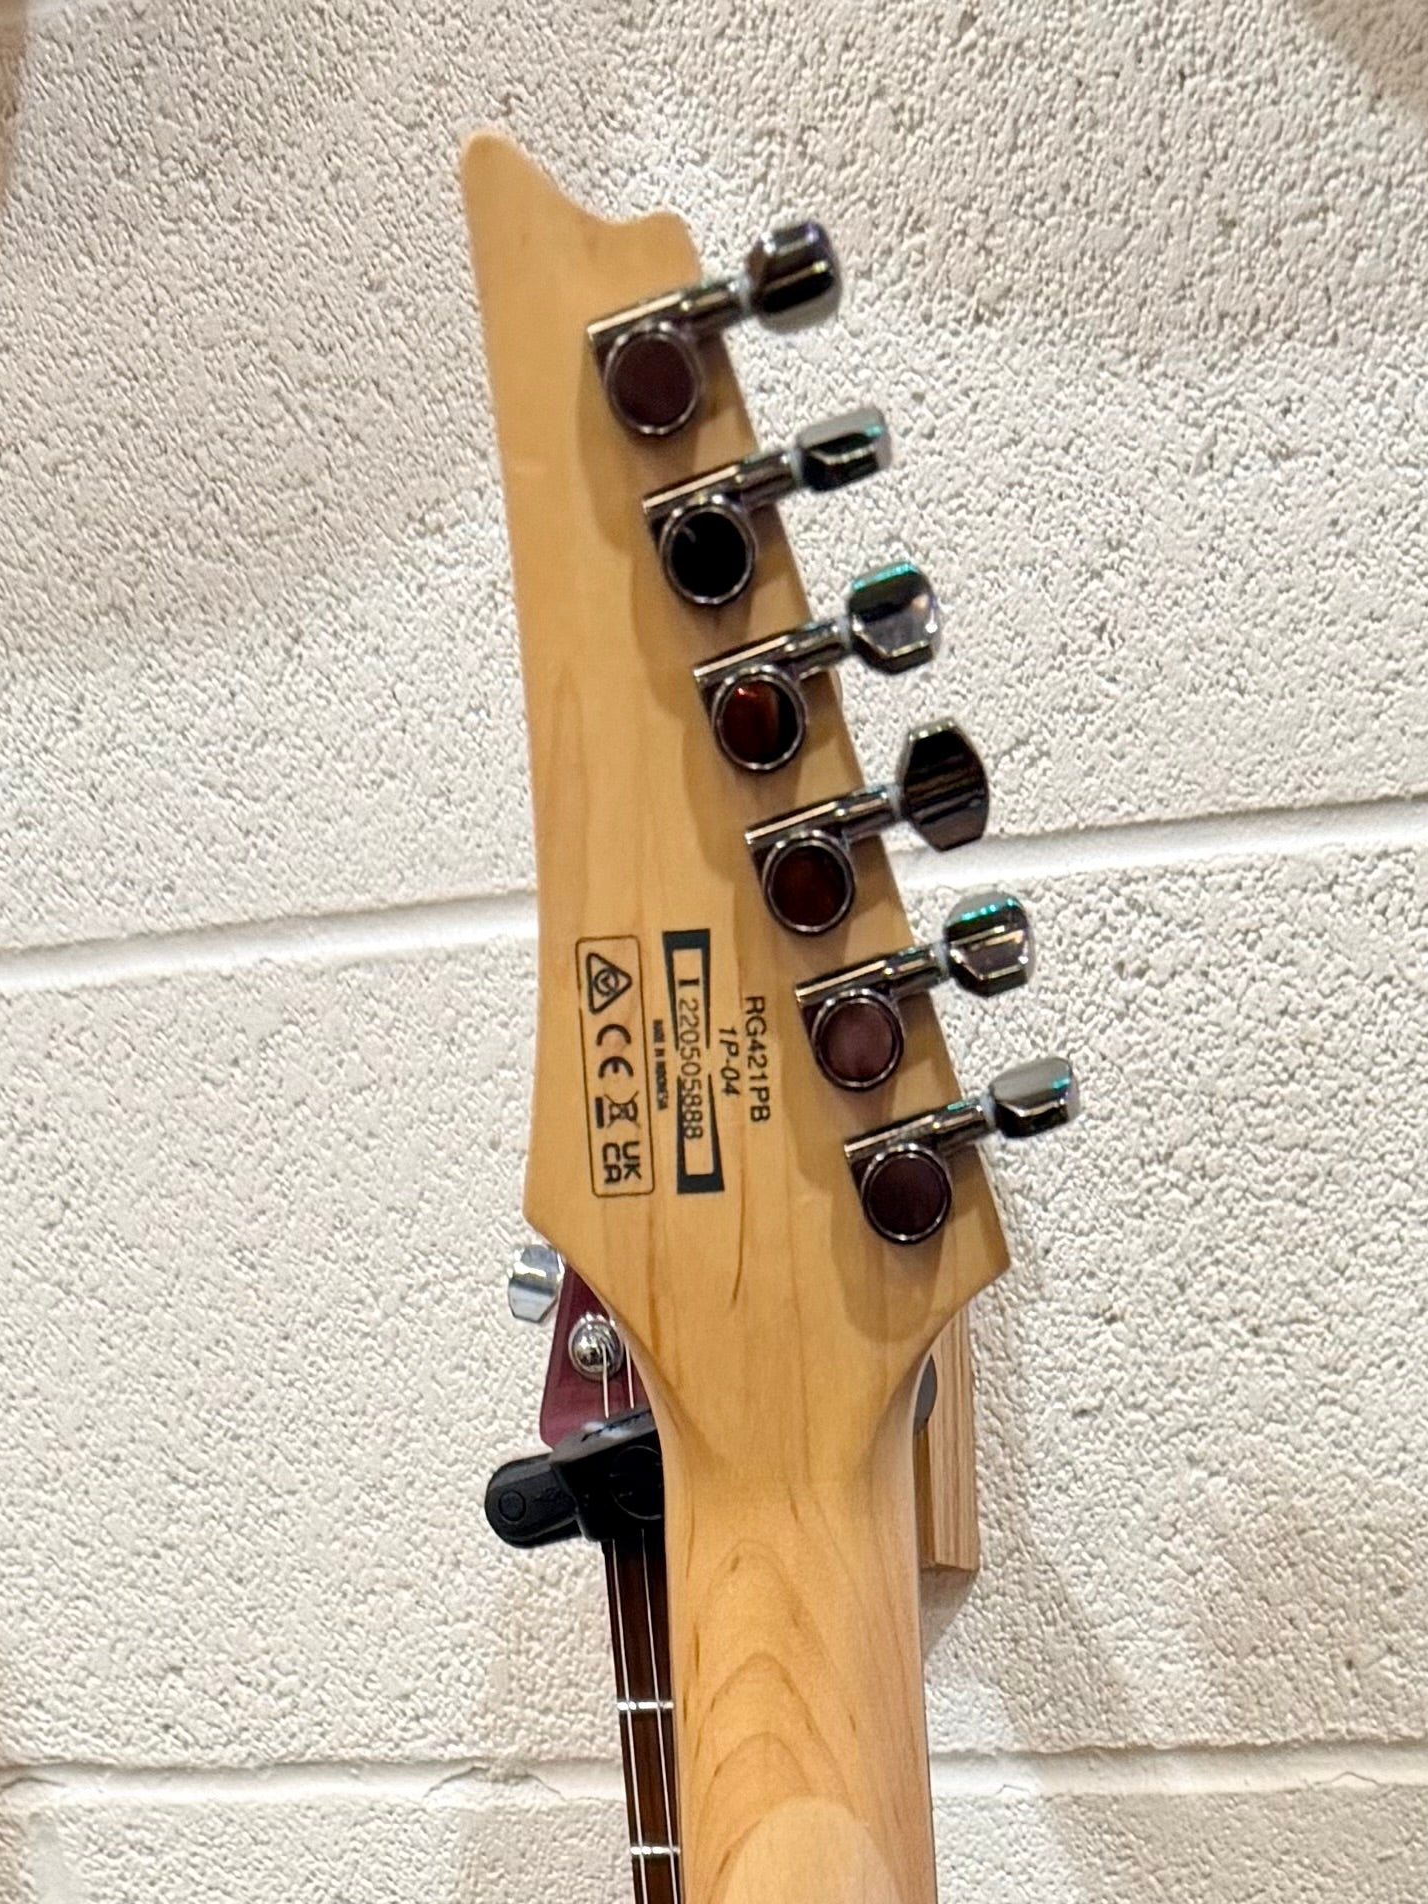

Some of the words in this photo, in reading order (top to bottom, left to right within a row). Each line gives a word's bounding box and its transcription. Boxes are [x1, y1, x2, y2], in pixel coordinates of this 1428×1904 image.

[678, 998, 704, 1141] 220505888
[744, 995, 771, 1123] RG421PB
[621, 1140, 643, 1181] UK
